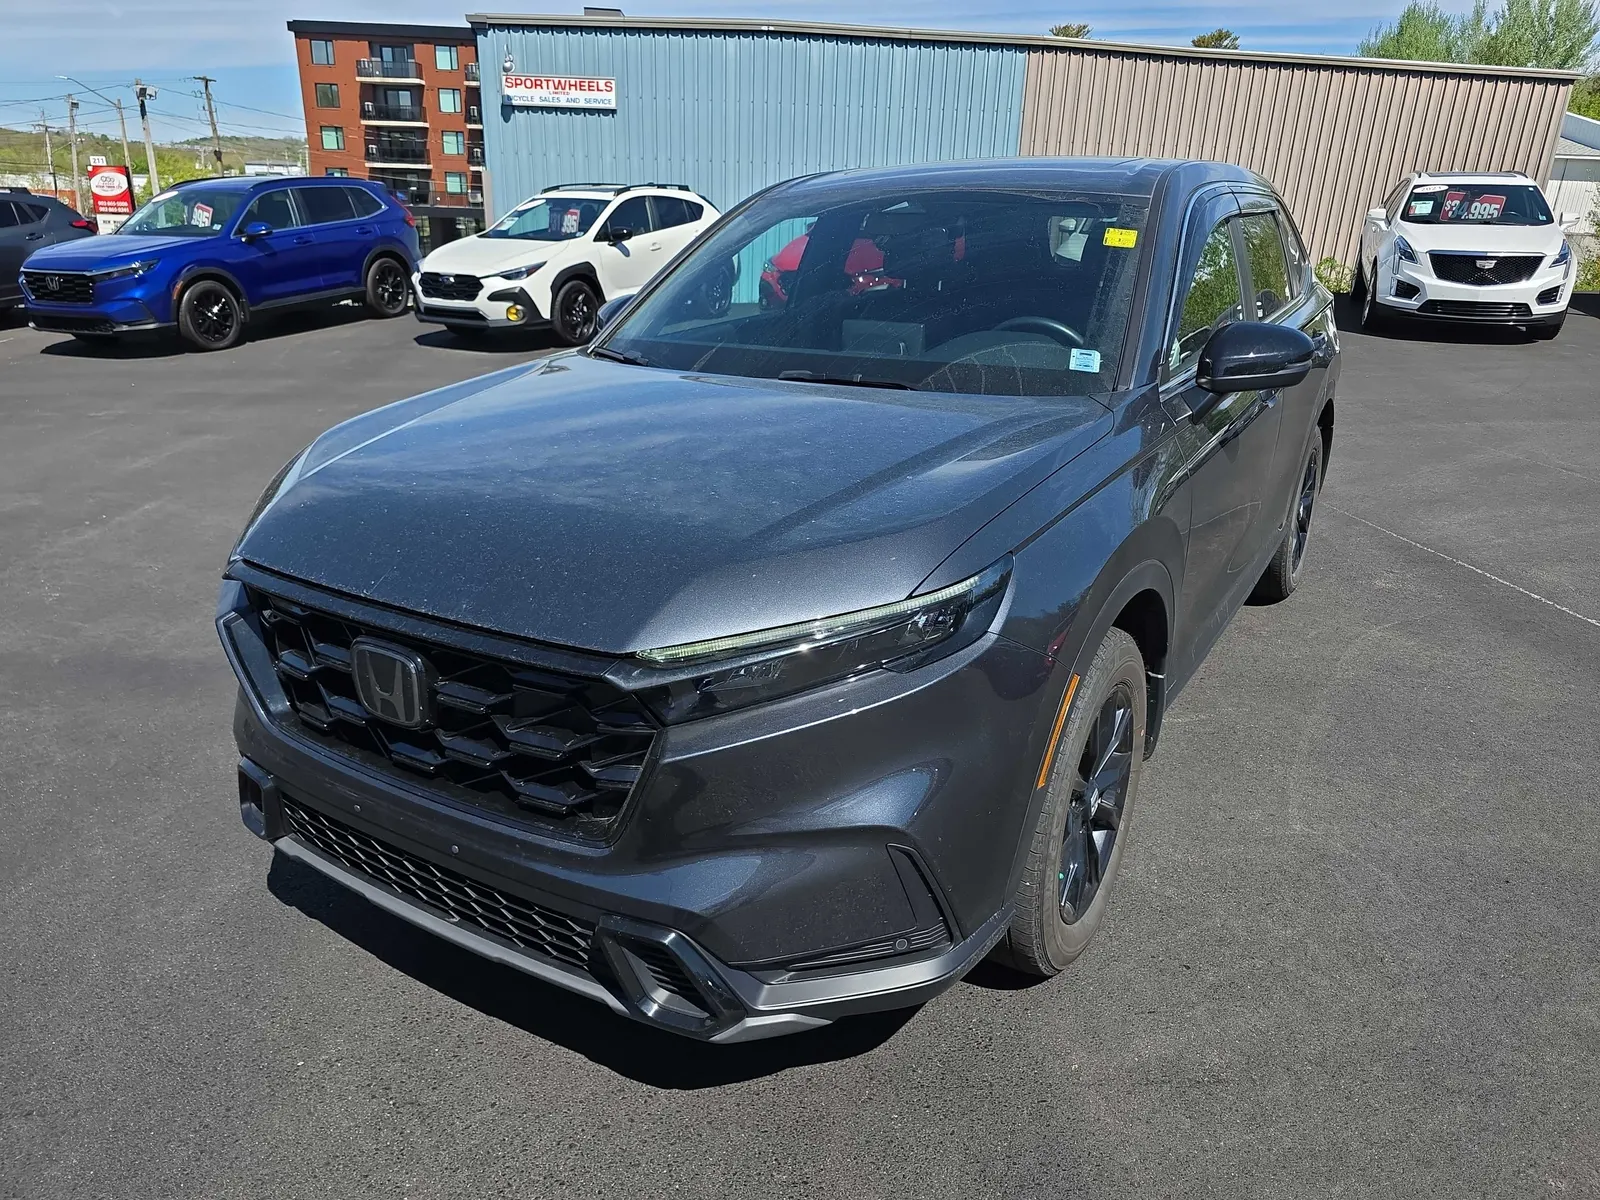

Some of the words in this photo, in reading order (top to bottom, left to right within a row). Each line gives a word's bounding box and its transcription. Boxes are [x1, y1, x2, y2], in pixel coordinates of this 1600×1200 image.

[505, 77, 613, 92] SPORTWHEELS
[539, 96, 561, 104] SALES
[584, 98, 612, 106] SERVICE
